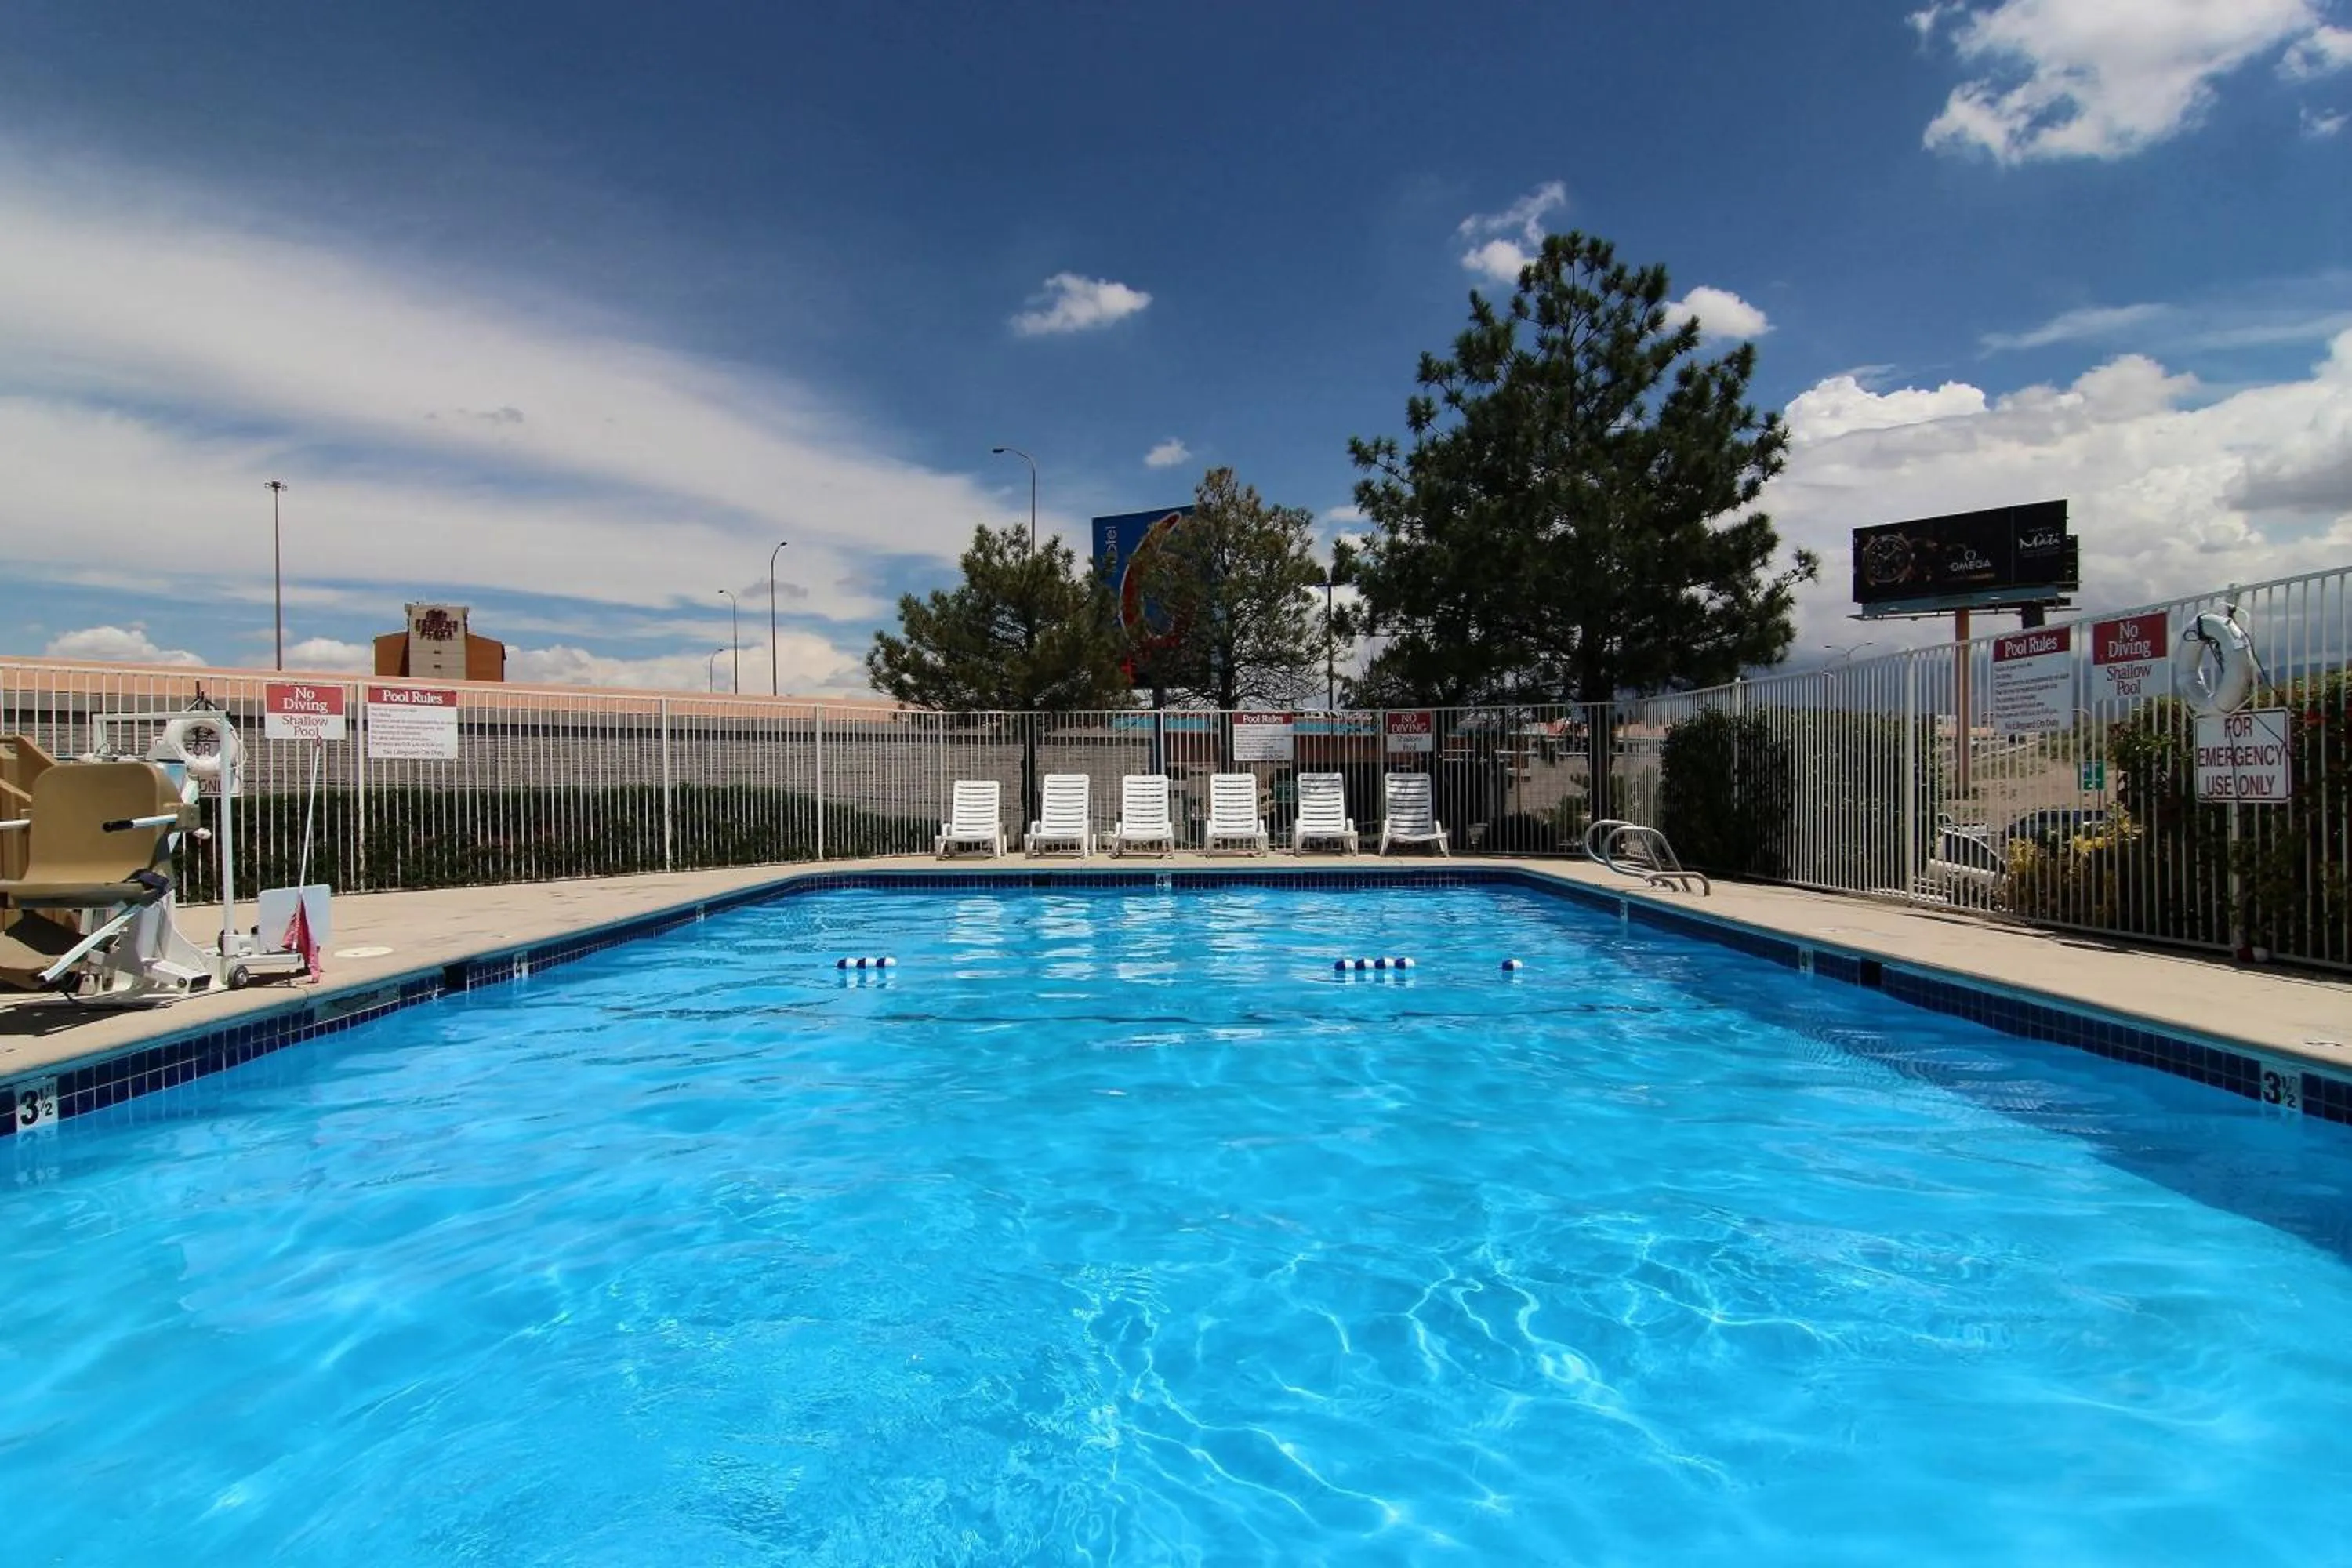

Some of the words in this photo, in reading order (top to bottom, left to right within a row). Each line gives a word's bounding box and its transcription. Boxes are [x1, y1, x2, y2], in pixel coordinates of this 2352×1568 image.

[1949, 558, 1992, 572] OMEGA
[2119, 621, 2139, 640] No
[2005, 639, 2027, 658] Pool
[2028, 636, 2058, 654] Rules
[2107, 638, 2152, 659] Diving
[2107, 664, 2152, 681] Shallow
[295, 687, 315, 700] No
[2117, 679, 2141, 696] Pool
[283, 697, 328, 713] Diving
[382, 690, 408, 702] Pool
[412, 691, 444, 705] Rules
[282, 715, 328, 726] Shallow
[1243, 714, 1260, 723] Pool
[1401, 714, 1417, 723] NO
[293, 726, 321, 737] Pool
[1392, 723, 1427, 733] DIVING
[2224, 717, 2252, 737] FOR
[185, 742, 211, 755] FOR
[2198, 745, 2284, 767] EMERGENCY
[2205, 775, 2233, 795] USE
[2238, 774, 2275, 796] ONLY
